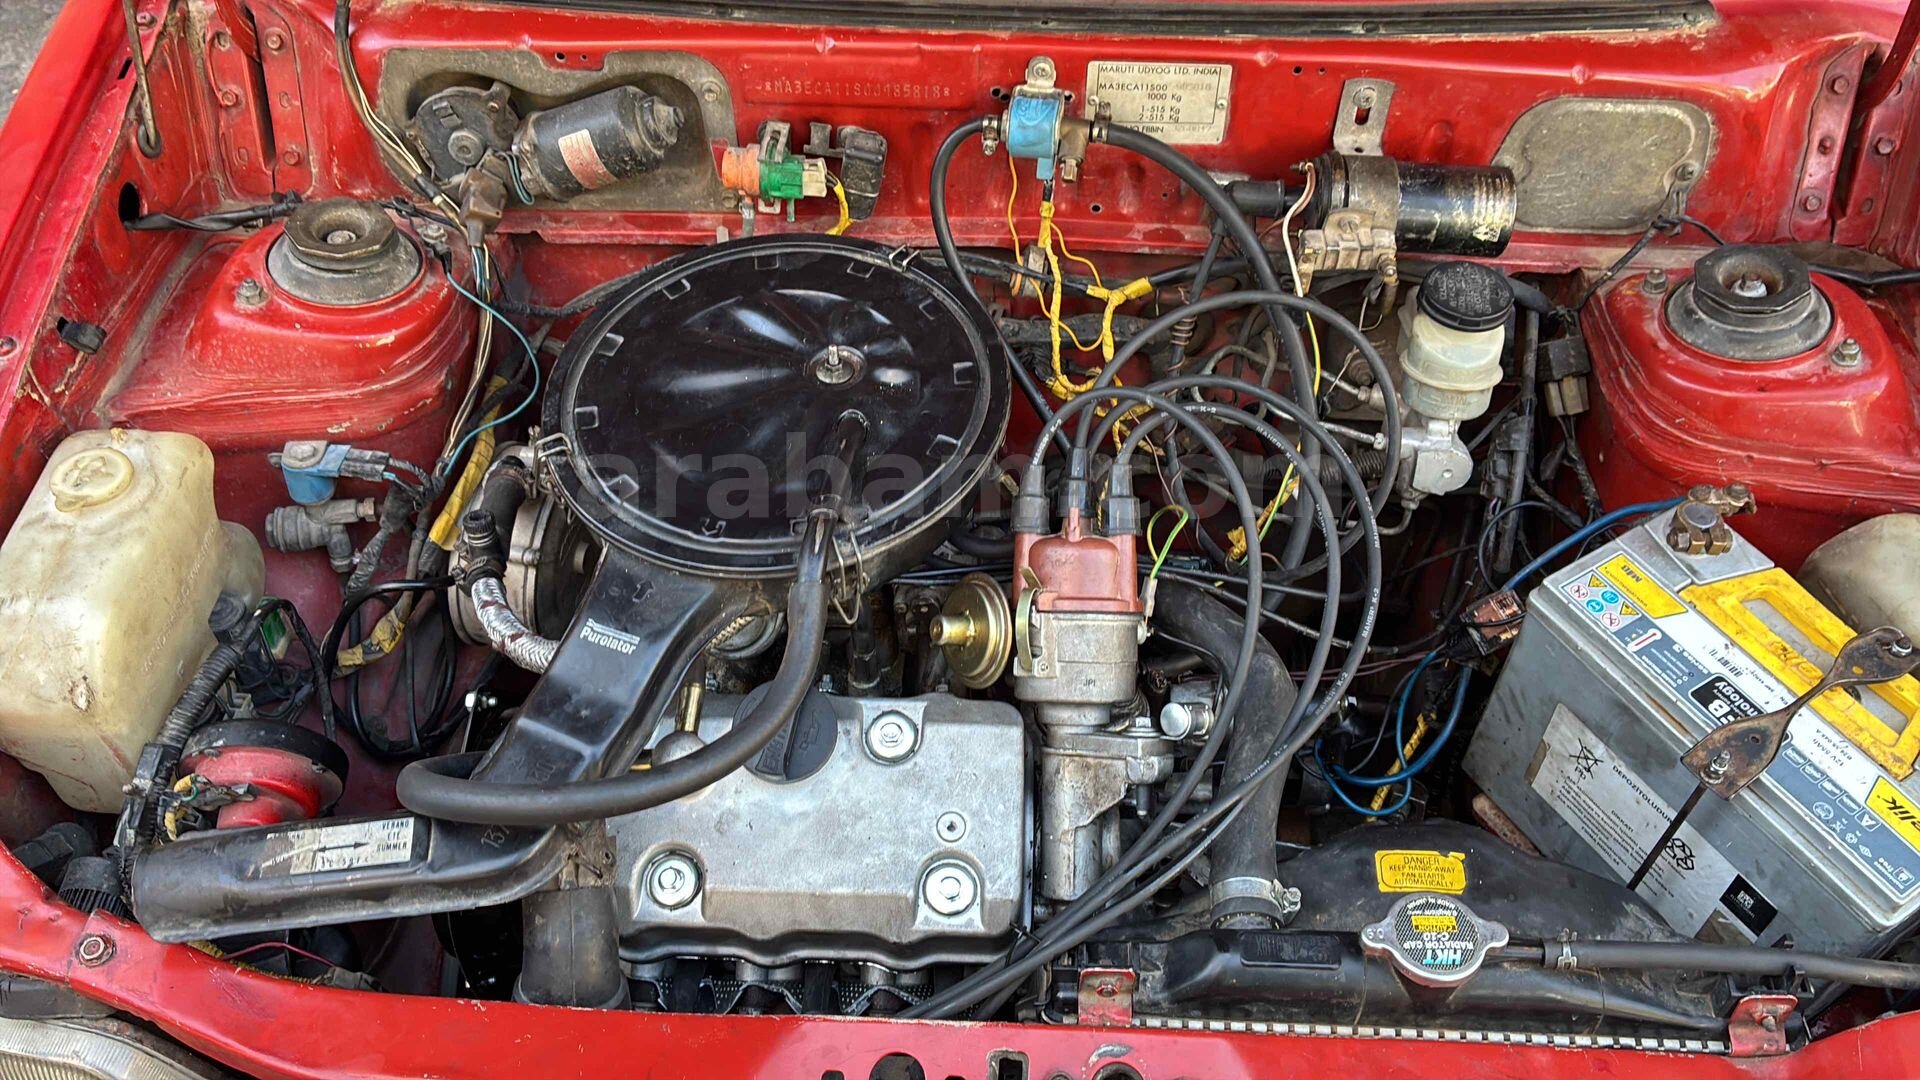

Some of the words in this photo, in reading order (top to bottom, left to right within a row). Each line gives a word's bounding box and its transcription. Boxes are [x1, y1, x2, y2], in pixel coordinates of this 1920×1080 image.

[1099, 66, 1135, 74] MARUTI
[1137, 67, 1171, 75] UDYOG
[1174, 68, 1190, 76] LTD.
[1193, 68, 1219, 76] INDIA
[1147, 93, 1167, 101] 1000
[1171, 93, 1182, 103] Kg
[1141, 105, 1166, 113] 1-515
[1169, 105, 1181, 115] Kg
[1138, 114, 1164, 122] 2-515
[1168, 114, 1180, 123] Kg
[580, 626, 637, 655] Purolator
[1714, 681, 1759, 717] nology
[382, 819, 409, 831] VERANO
[376, 842, 408, 852] SUMMER
[1403, 856, 1440, 865] DANGER
[1389, 864, 1408, 872] KEEP
[1393, 879, 1455, 888] AUTOMATICALLY
[1423, 932, 1450, 940] C-10
[1402, 941, 1423, 950] CAP
[1425, 941, 1474, 950] RADIATOR
[1422, 949, 1462, 965] HKT
